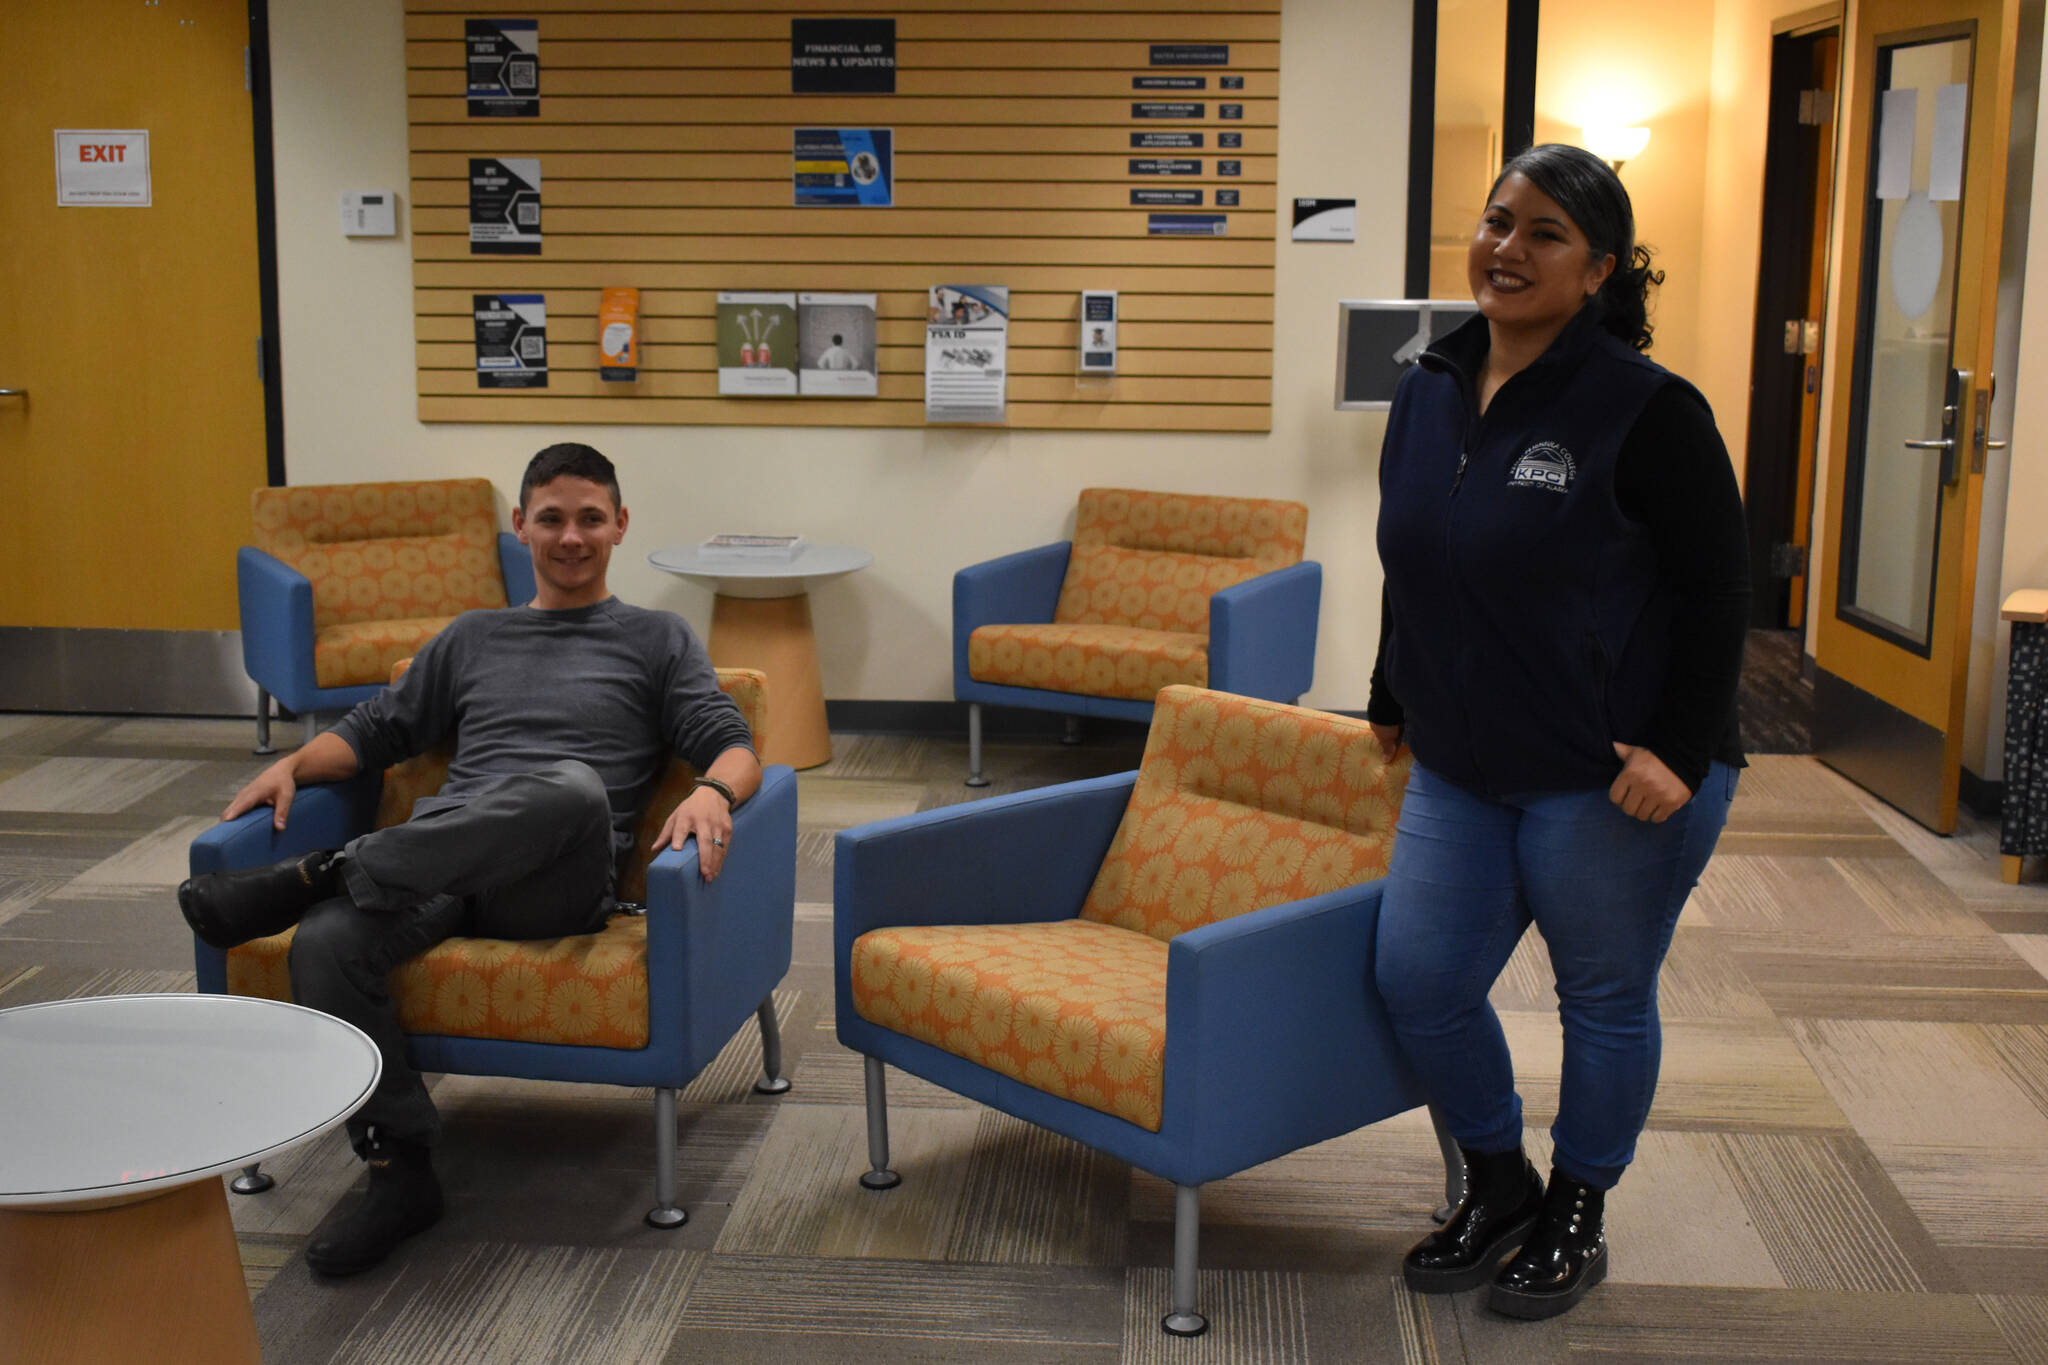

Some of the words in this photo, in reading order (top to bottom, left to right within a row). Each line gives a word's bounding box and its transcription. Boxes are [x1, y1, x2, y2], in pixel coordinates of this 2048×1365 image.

[804, 44, 861, 53] FINANCIAL
[863, 44, 883, 53] AID
[792, 57, 826, 67] NEWS
[841, 57, 895, 67] UPDATES
[79, 144, 127, 163] EXIT
[1517, 468, 1562, 484] KPC
